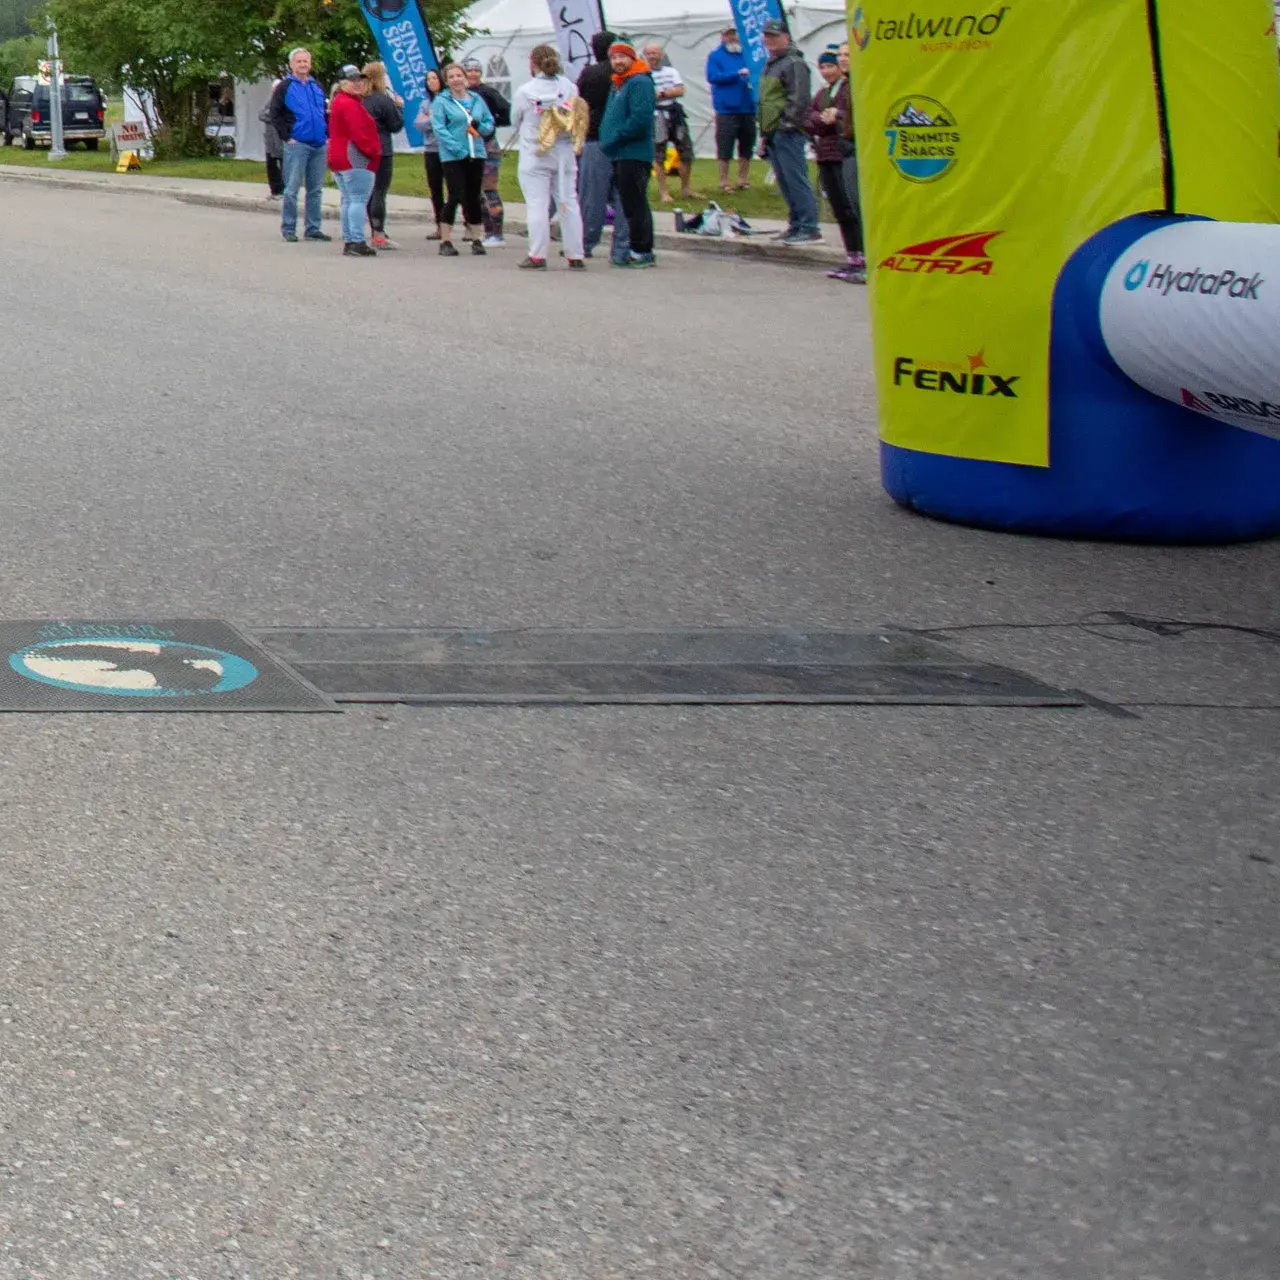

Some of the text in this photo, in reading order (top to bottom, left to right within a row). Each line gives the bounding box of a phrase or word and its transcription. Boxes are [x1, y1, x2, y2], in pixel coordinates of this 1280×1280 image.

[875, 6, 1006, 41] tailwind
[382, 25, 419, 102] SPORTS
[122, 124, 138, 133] NO
[885, 129, 961, 156] 7 SUMMITS
[878, 256, 994, 277] ALTRA
[1146, 262, 1265, 301] HydraPak
[893, 356, 1021, 398] FENIX
